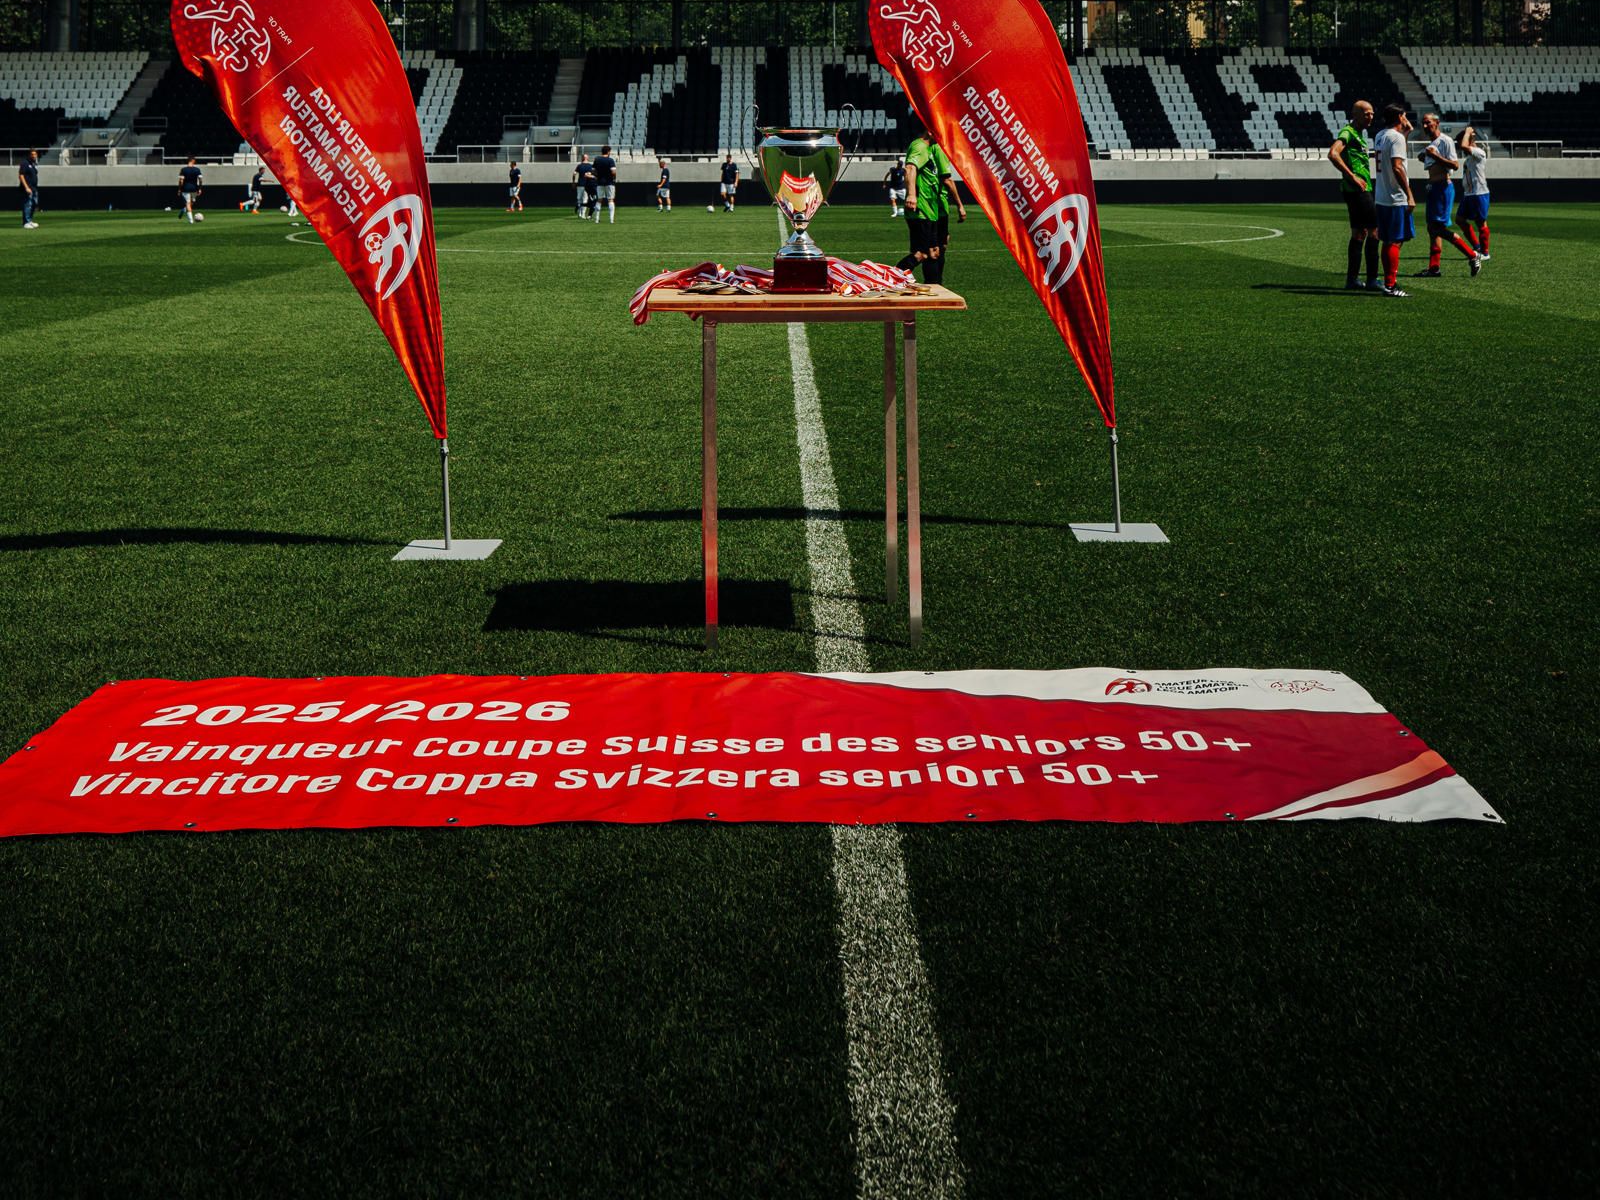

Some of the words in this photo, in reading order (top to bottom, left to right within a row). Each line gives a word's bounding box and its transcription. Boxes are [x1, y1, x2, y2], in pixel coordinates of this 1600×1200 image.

[141, 700, 571, 726] 2025/2026
[109, 739, 403, 767] Vainqueur
[412, 738, 587, 759] Coupe
[601, 733, 785, 756] Suisse
[801, 733, 900, 753] des
[914, 734, 1126, 755] seniors
[1138, 731, 1252, 752] 50+
[70, 771, 338, 796] Vincitore
[355, 768, 538, 794] Coppa
[554, 764, 800, 789] Svizzera
[819, 763, 1025, 786] seniori
[1041, 763, 1159, 785] 50+
